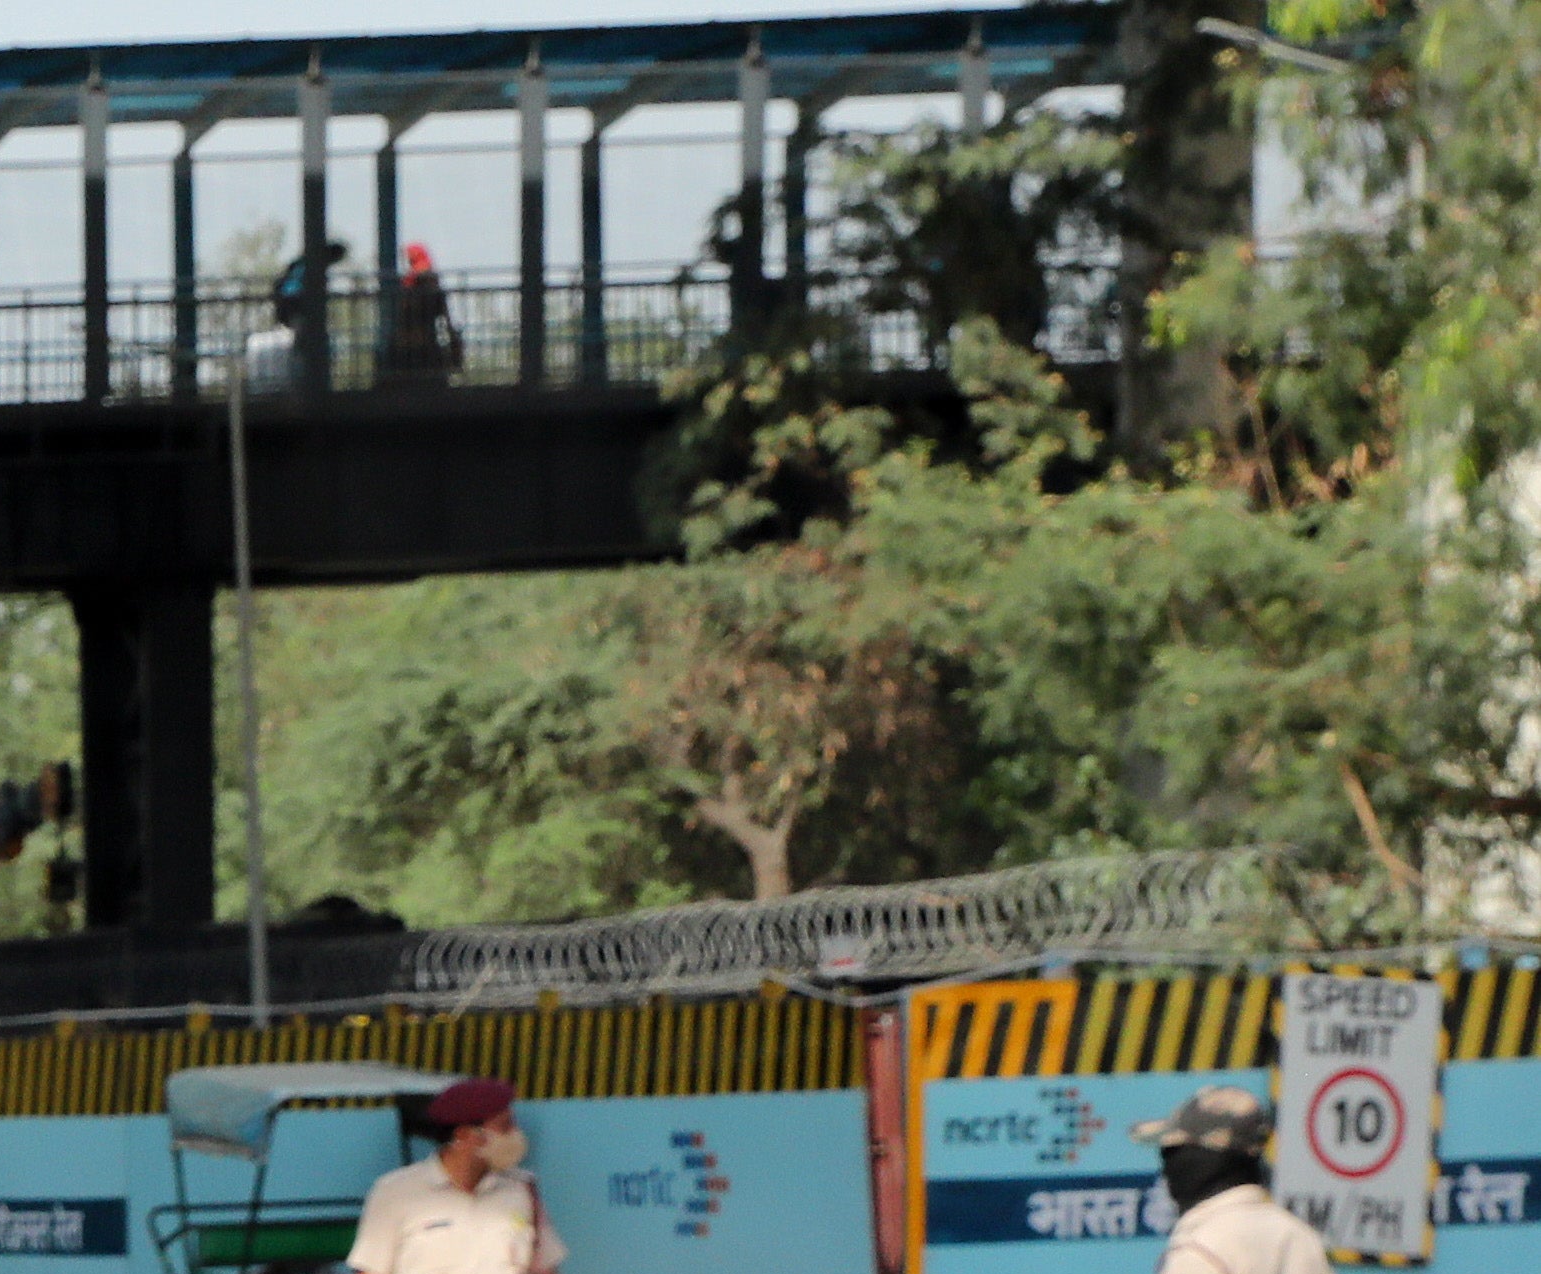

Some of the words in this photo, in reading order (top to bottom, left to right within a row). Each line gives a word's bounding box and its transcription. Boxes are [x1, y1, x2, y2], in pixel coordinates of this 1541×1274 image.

[1299, 979, 1417, 1021] SPEED
[1305, 1022, 1399, 1059] LIMIT
[942, 1111, 1039, 1145] ncrtc
[1332, 1099, 1385, 1145] 10
[1026, 1187, 1139, 1240] भारत
